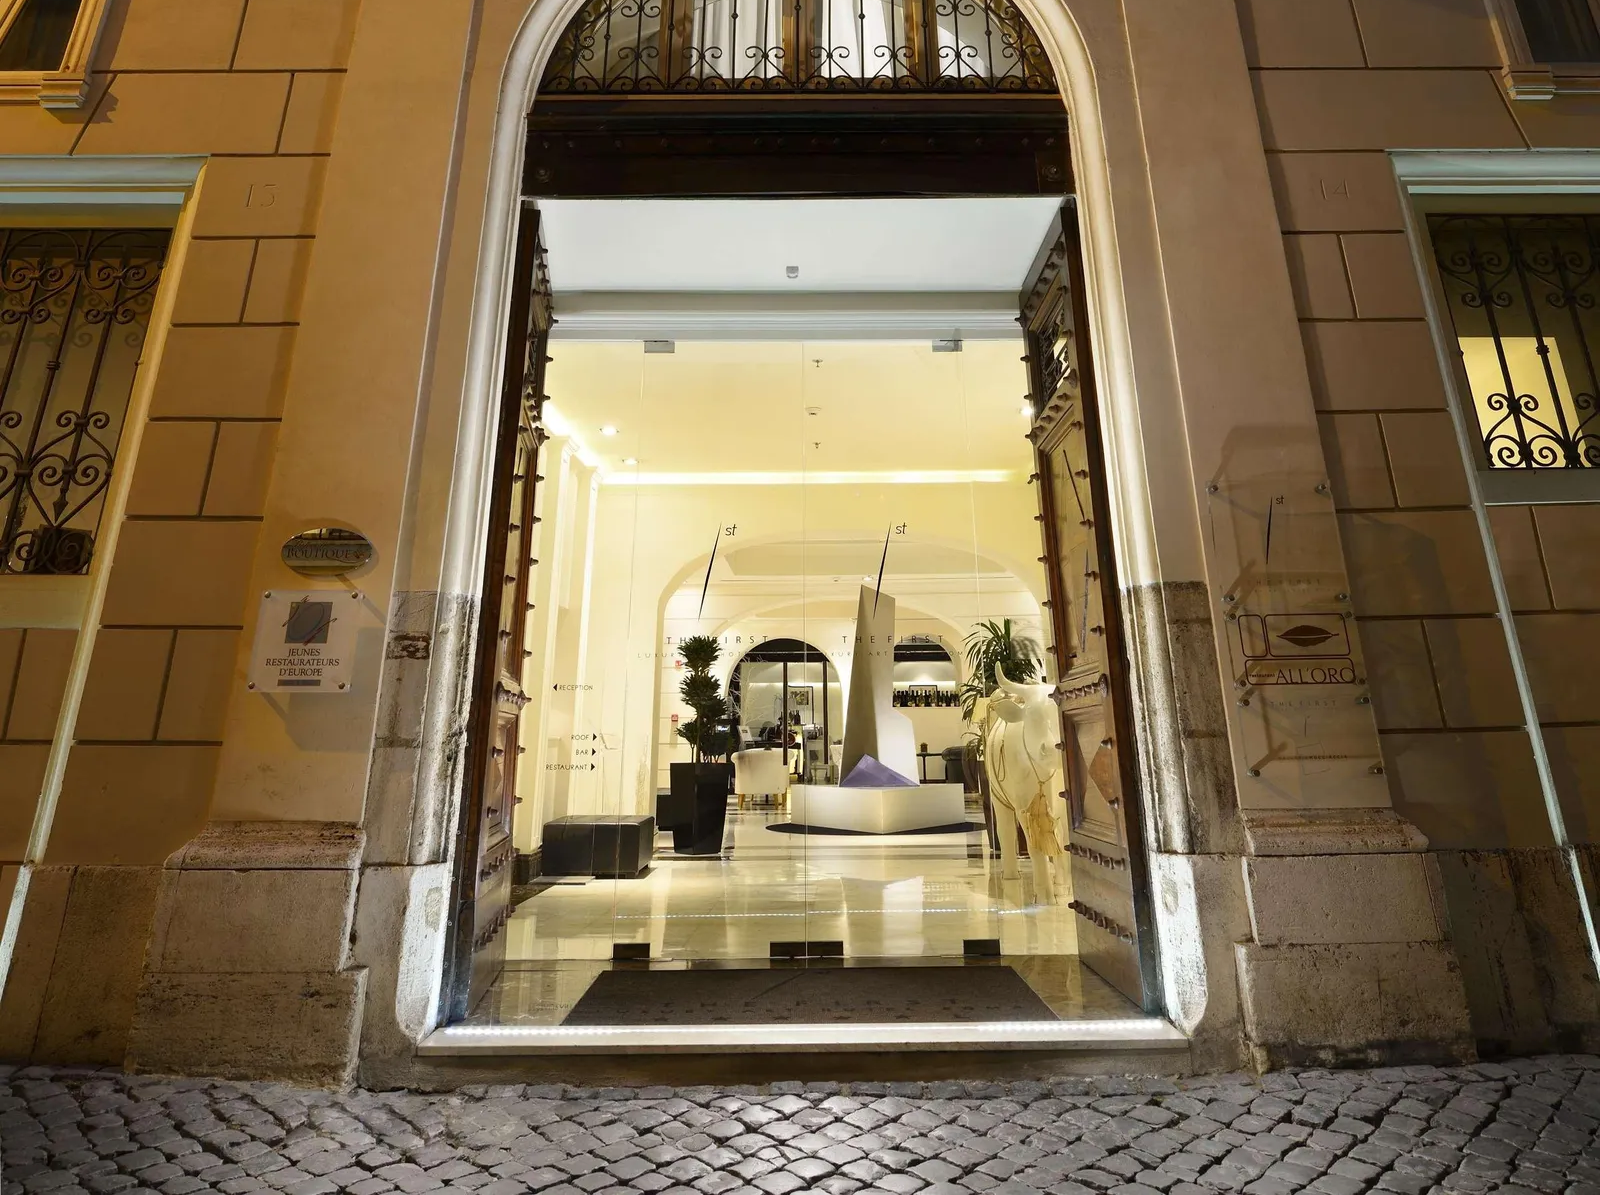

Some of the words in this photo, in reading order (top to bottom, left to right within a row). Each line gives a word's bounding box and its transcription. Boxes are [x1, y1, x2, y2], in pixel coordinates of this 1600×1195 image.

[842, 635, 876, 644] THE
[887, 635, 943, 643] FIRST
[287, 648, 321, 658] JEUNES
[265, 658, 340, 667] RESTAURATEURS
[278, 668, 323, 677] D'EUROPE
[1276, 667, 1356, 684] ALL'ORO
[545, 763, 588, 771] RESTAURANT
